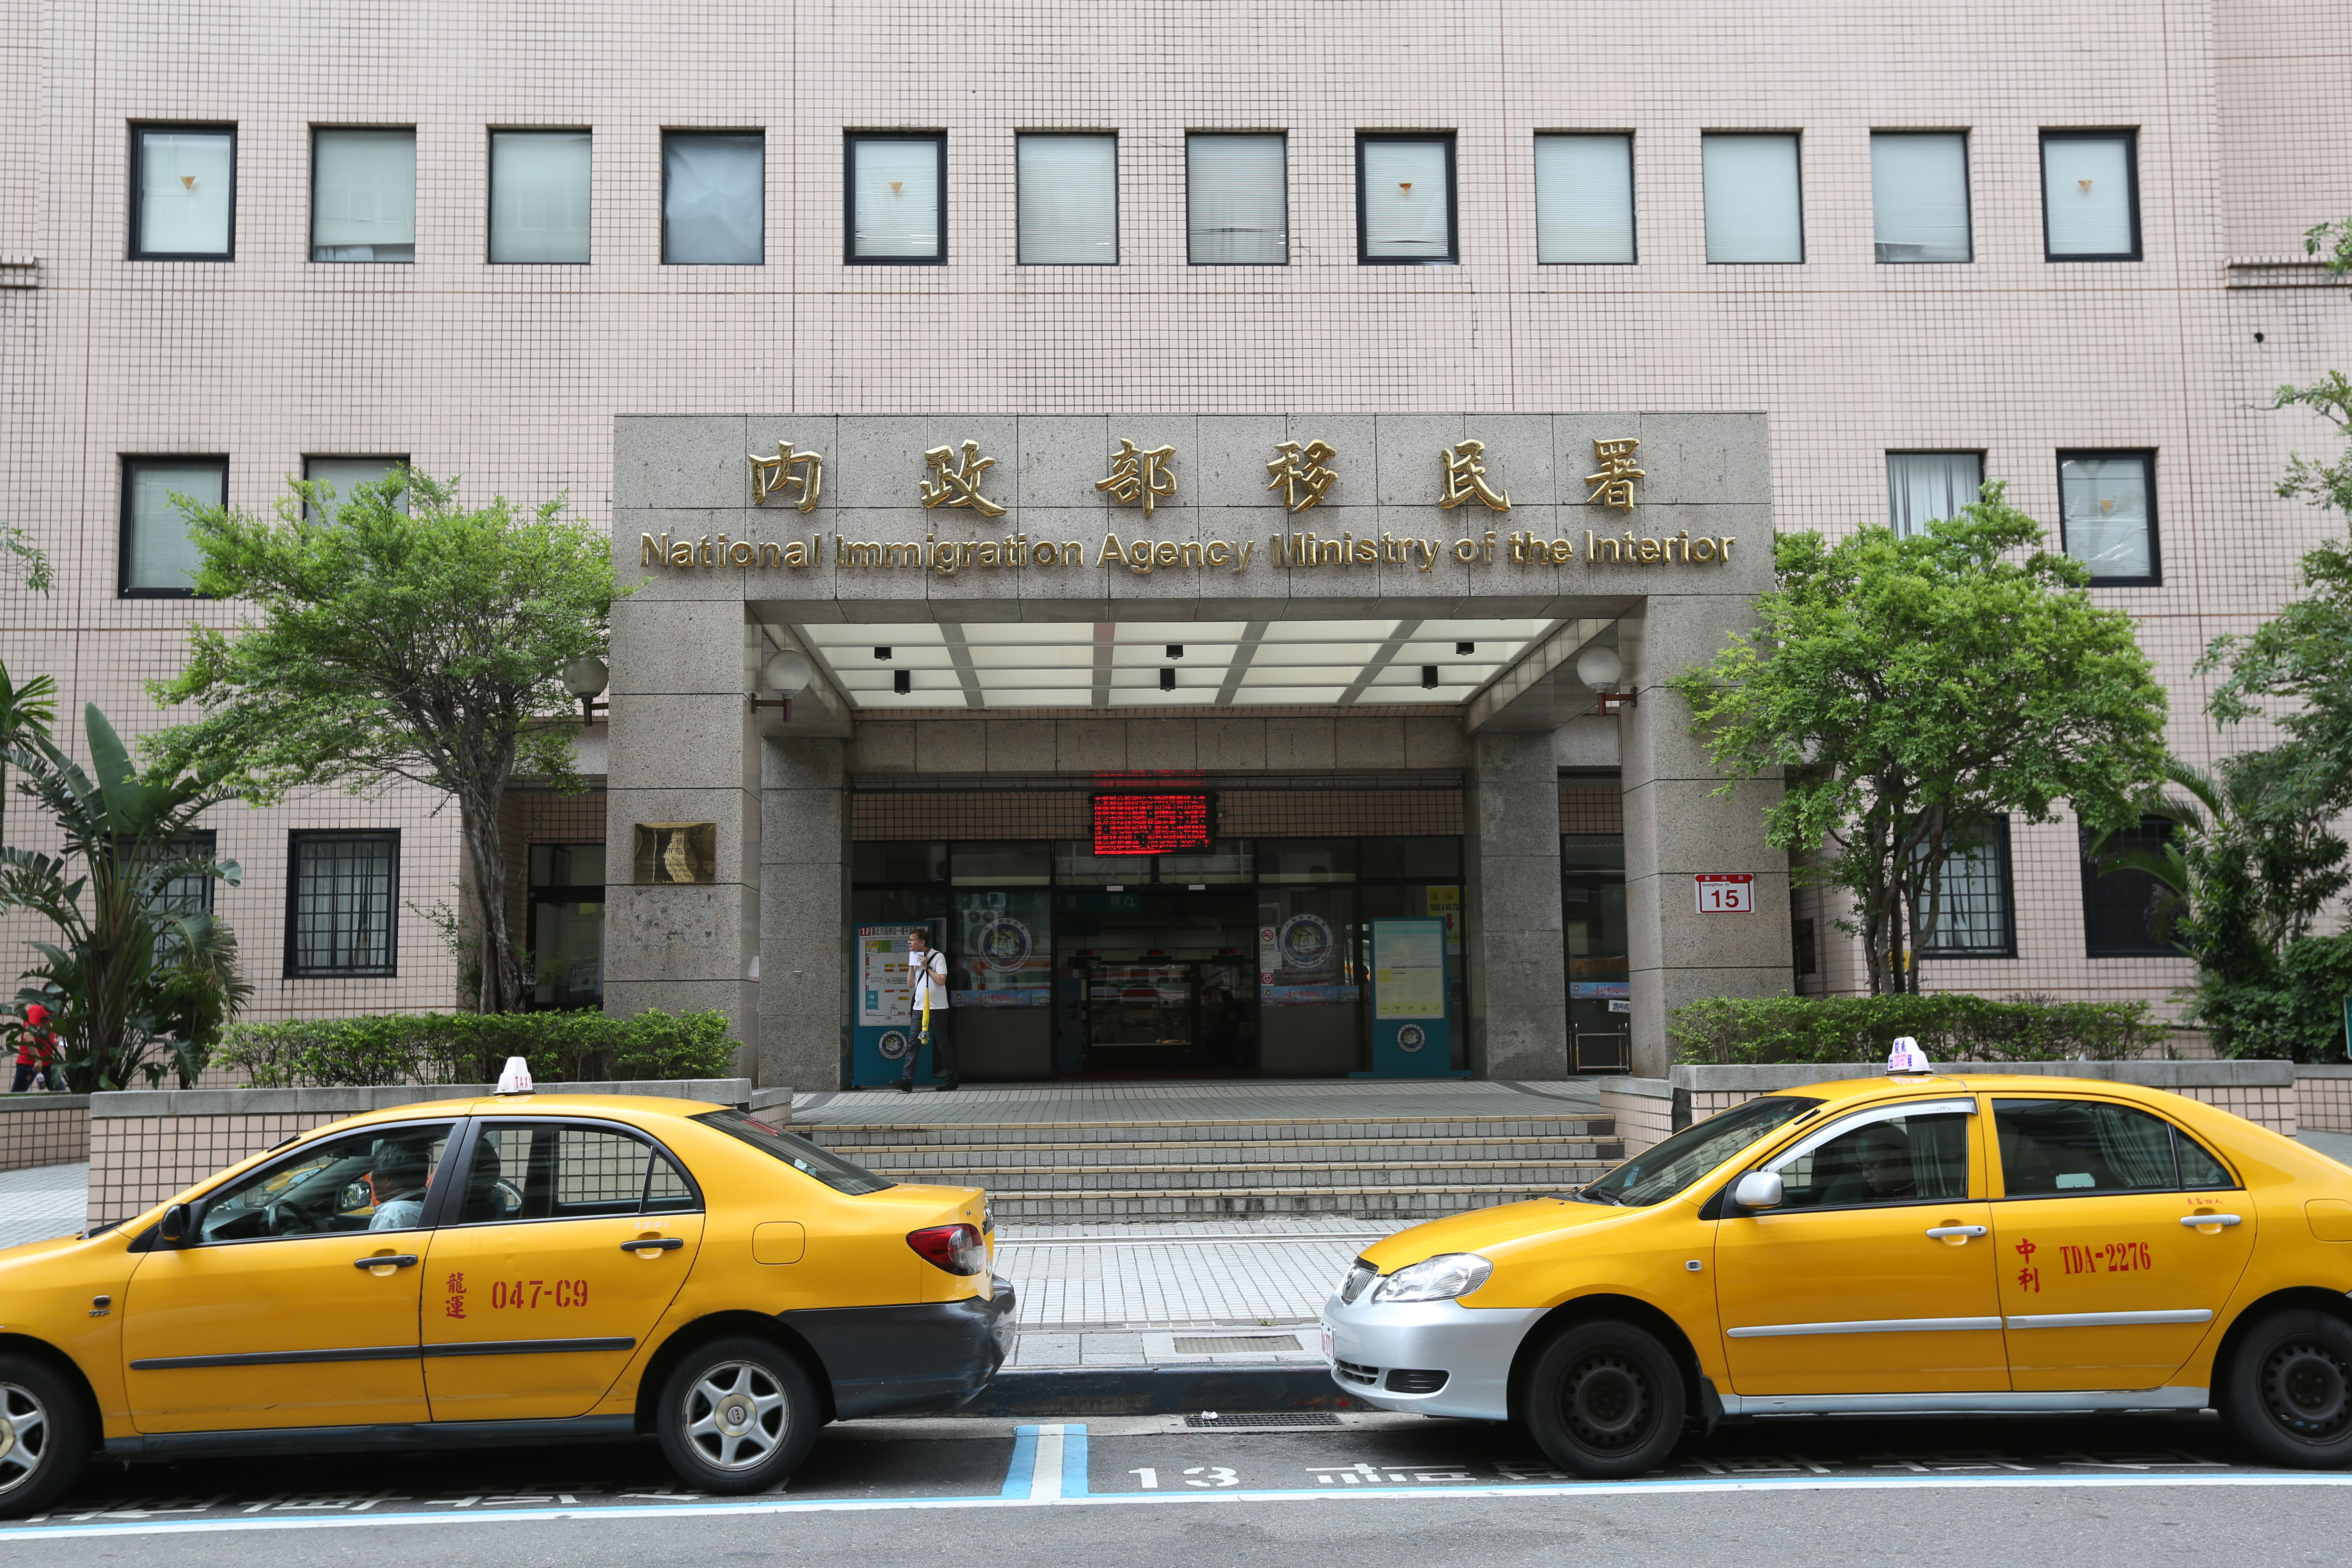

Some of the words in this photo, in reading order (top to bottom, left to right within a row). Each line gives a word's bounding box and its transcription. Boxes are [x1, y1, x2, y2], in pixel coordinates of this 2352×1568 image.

[748, 437, 1646, 519] 內政部移民署
[640, 532, 822, 568] National
[835, 533, 1083, 576] Immigration
[1096, 532, 1256, 575] Agency
[1272, 531, 1443, 572] Ministry
[1453, 530, 1496, 565] of
[1508, 530, 1573, 566] the
[1584, 529, 1737, 565] Interior
[1711, 890, 1739, 908] 15
[980, 950, 993, 968] National
[993, 963, 1020, 972] Immigration
[1281, 947, 1295, 964] National
[1294, 959, 1321, 968] Immigration
[514, 1076, 532, 1089] TAXI
[2015, 1237, 2040, 1294] 中利
[2060, 1241, 2152, 1275] TDA-2276
[445, 1272, 467, 1319] 龍運
[492, 1279, 588, 1310] 047-C9
[1128, 1467, 1240, 1488] 13
